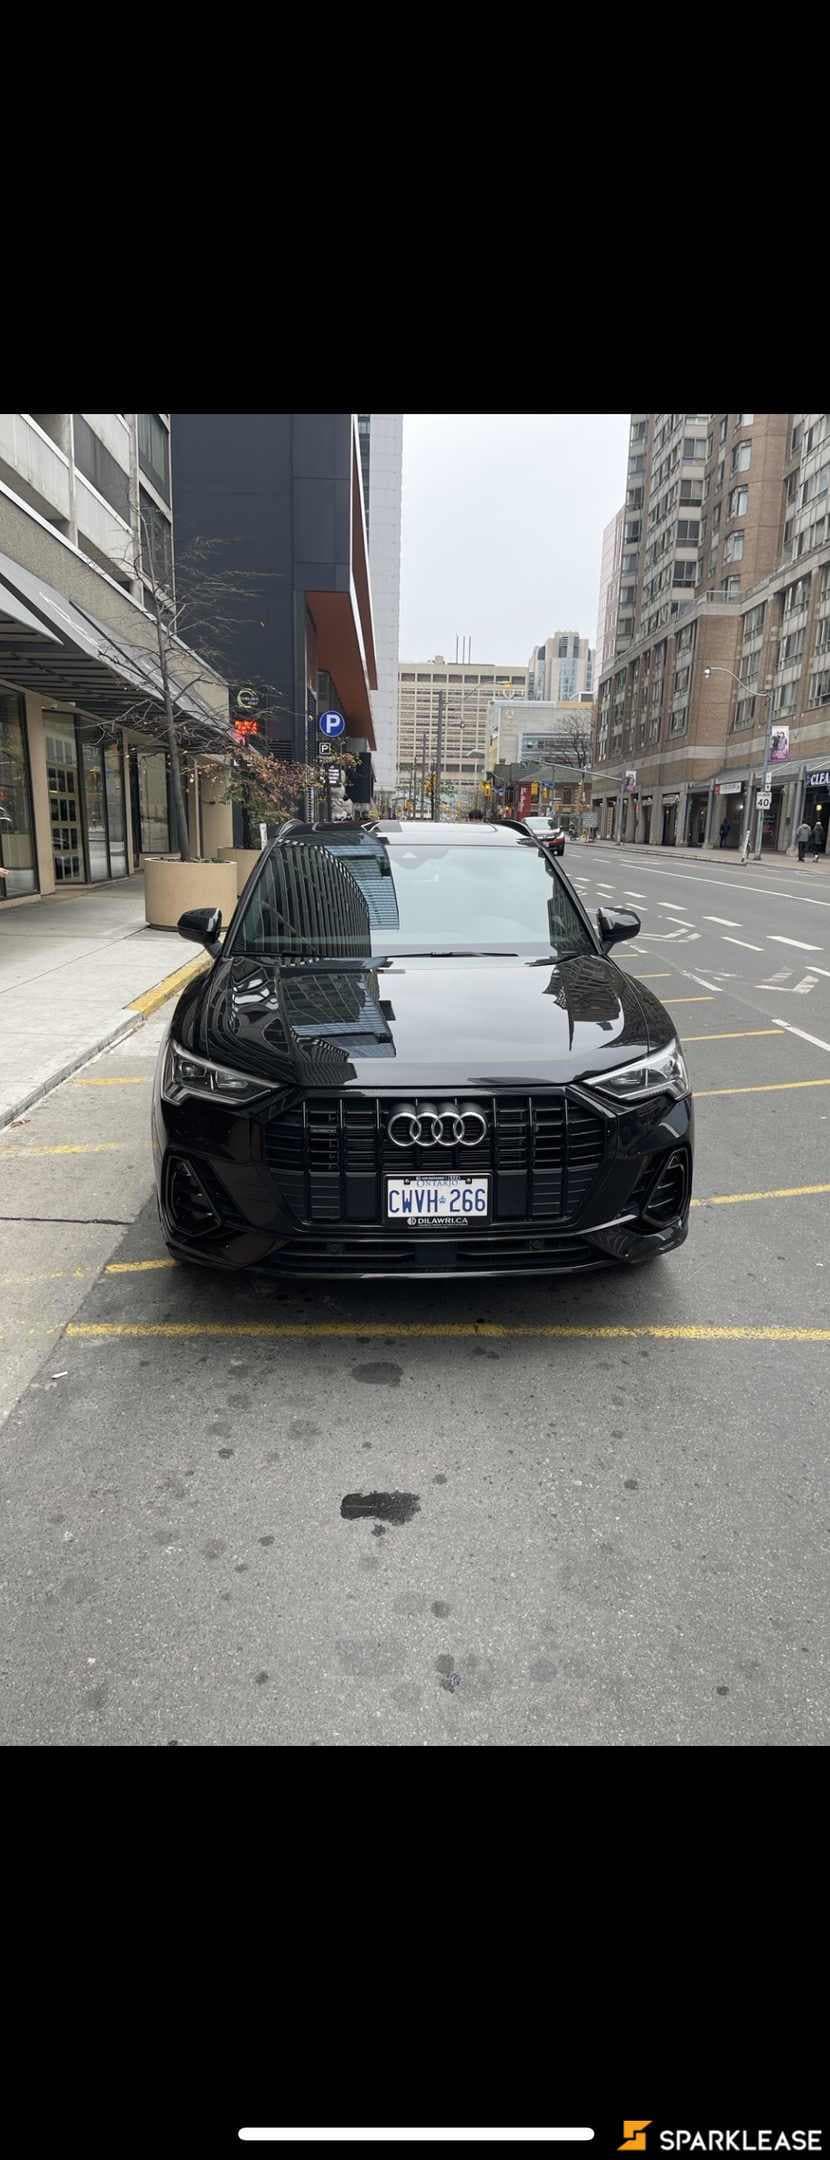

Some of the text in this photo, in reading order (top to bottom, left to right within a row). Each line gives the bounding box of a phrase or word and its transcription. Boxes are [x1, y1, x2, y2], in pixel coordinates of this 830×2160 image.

[326, 714, 340, 733] P
[758, 799, 769, 807] 40
[389, 1189, 485, 1213] CWVH 266
[418, 1217, 468, 1225] DILAWRI.CA
